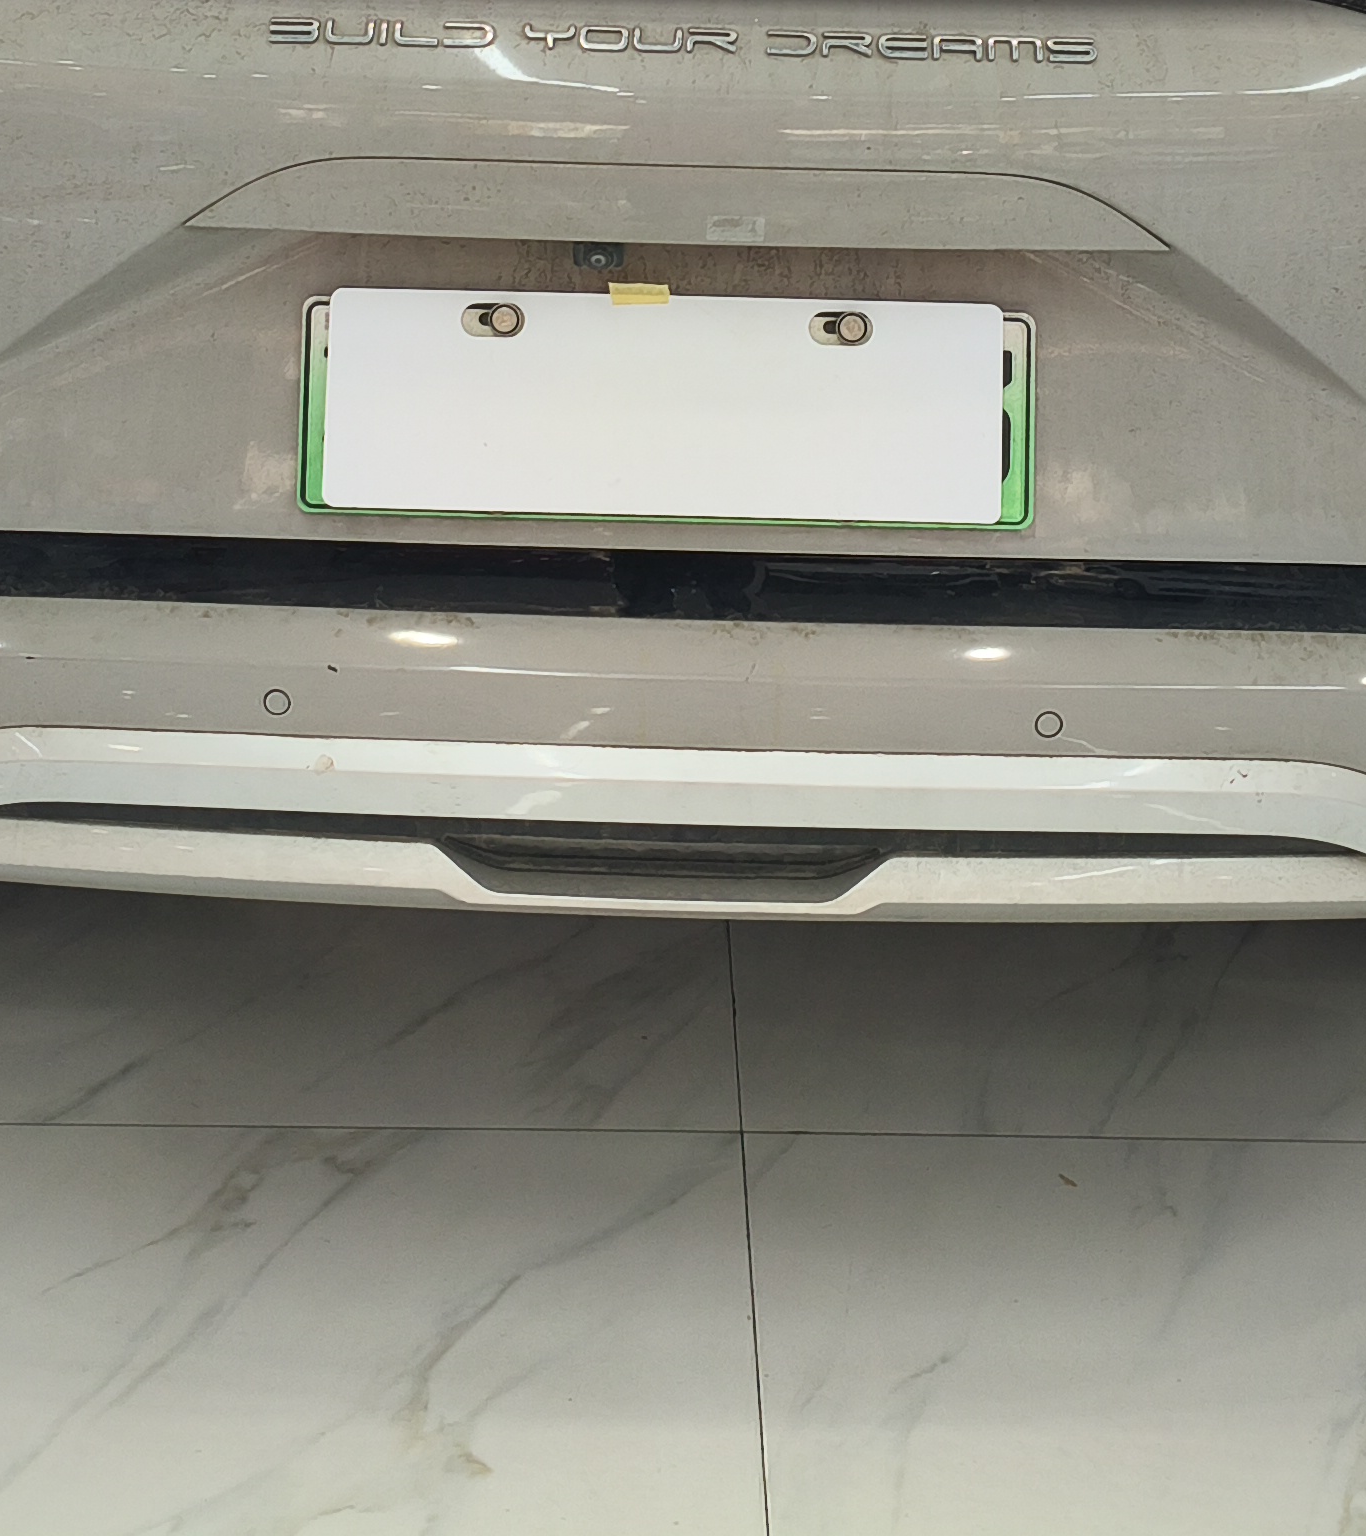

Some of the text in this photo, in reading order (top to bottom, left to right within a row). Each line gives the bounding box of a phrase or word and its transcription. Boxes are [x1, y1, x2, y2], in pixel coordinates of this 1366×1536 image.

[266, 15, 1100, 66] BUILD YOUR DREAMS
